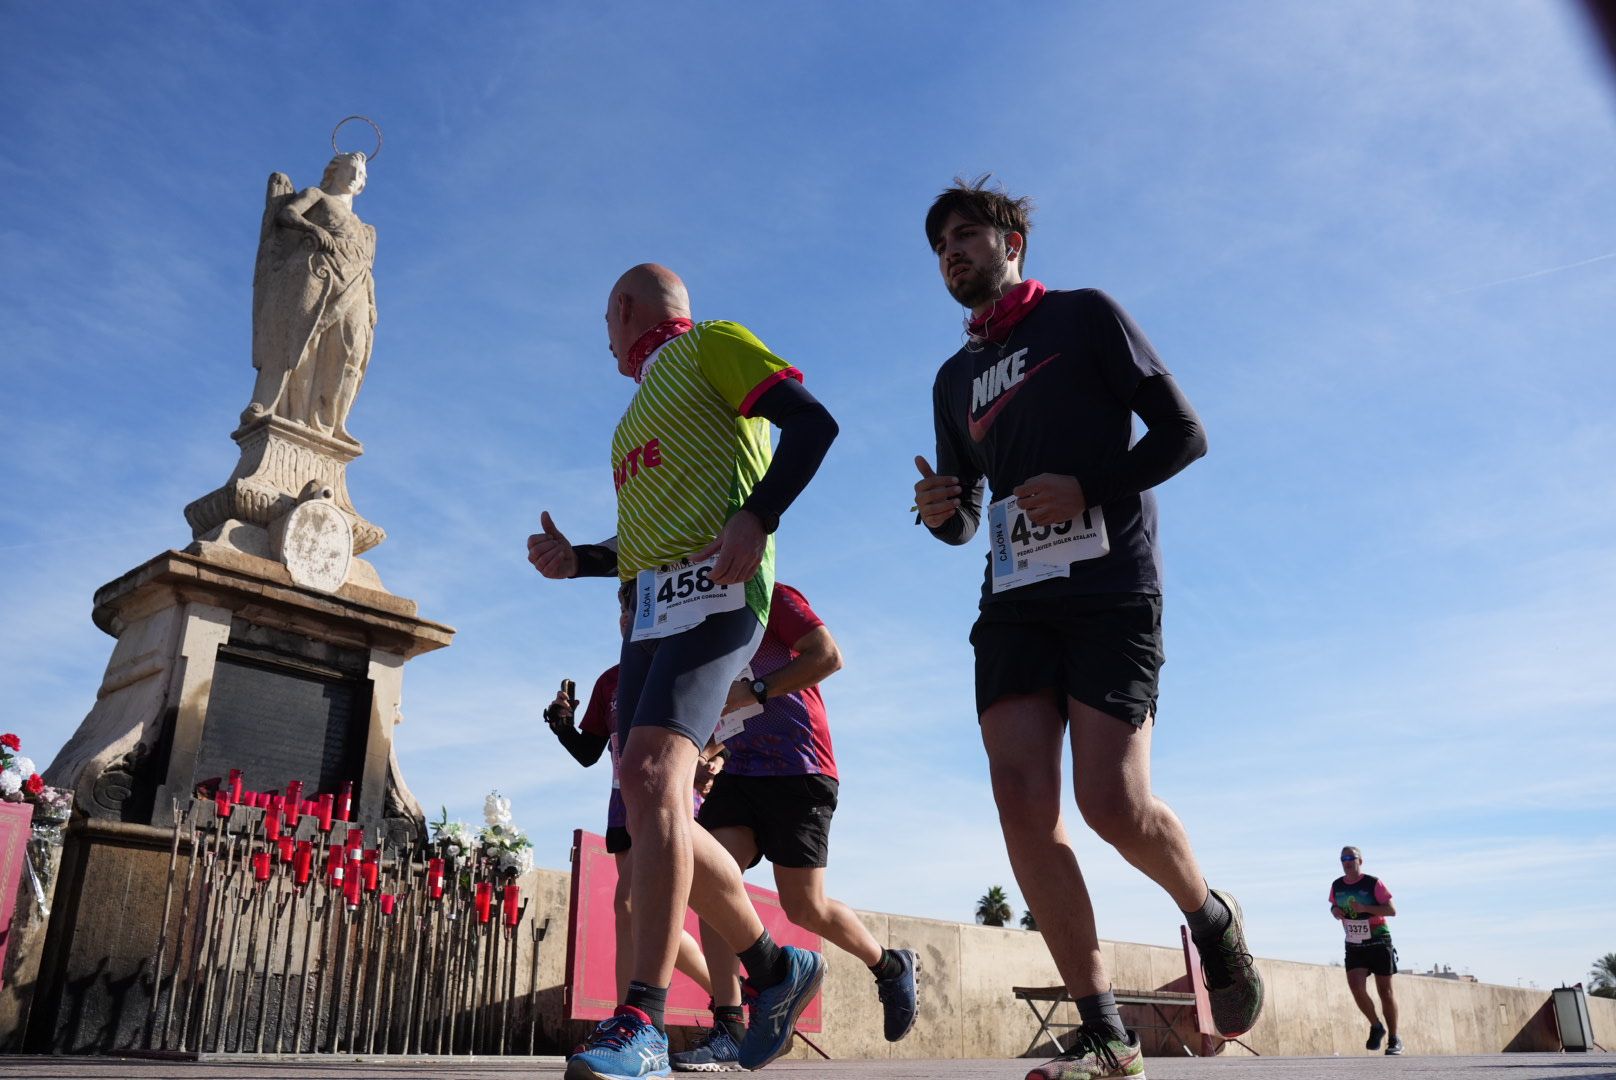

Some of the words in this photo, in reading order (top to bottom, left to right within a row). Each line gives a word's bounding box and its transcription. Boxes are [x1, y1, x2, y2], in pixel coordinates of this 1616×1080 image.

[972, 347, 1028, 413] NIKE
[996, 530, 1007, 562] CAJÓN
[1017, 548, 1034, 557] PEDRO
[1035, 542, 1053, 552] JAVIER
[1072, 532, 1097, 541] ATALAYA
[656, 566, 728, 604] 458
[642, 592, 652, 618] CAJÓN
[1348, 924, 1369, 933] 3375
